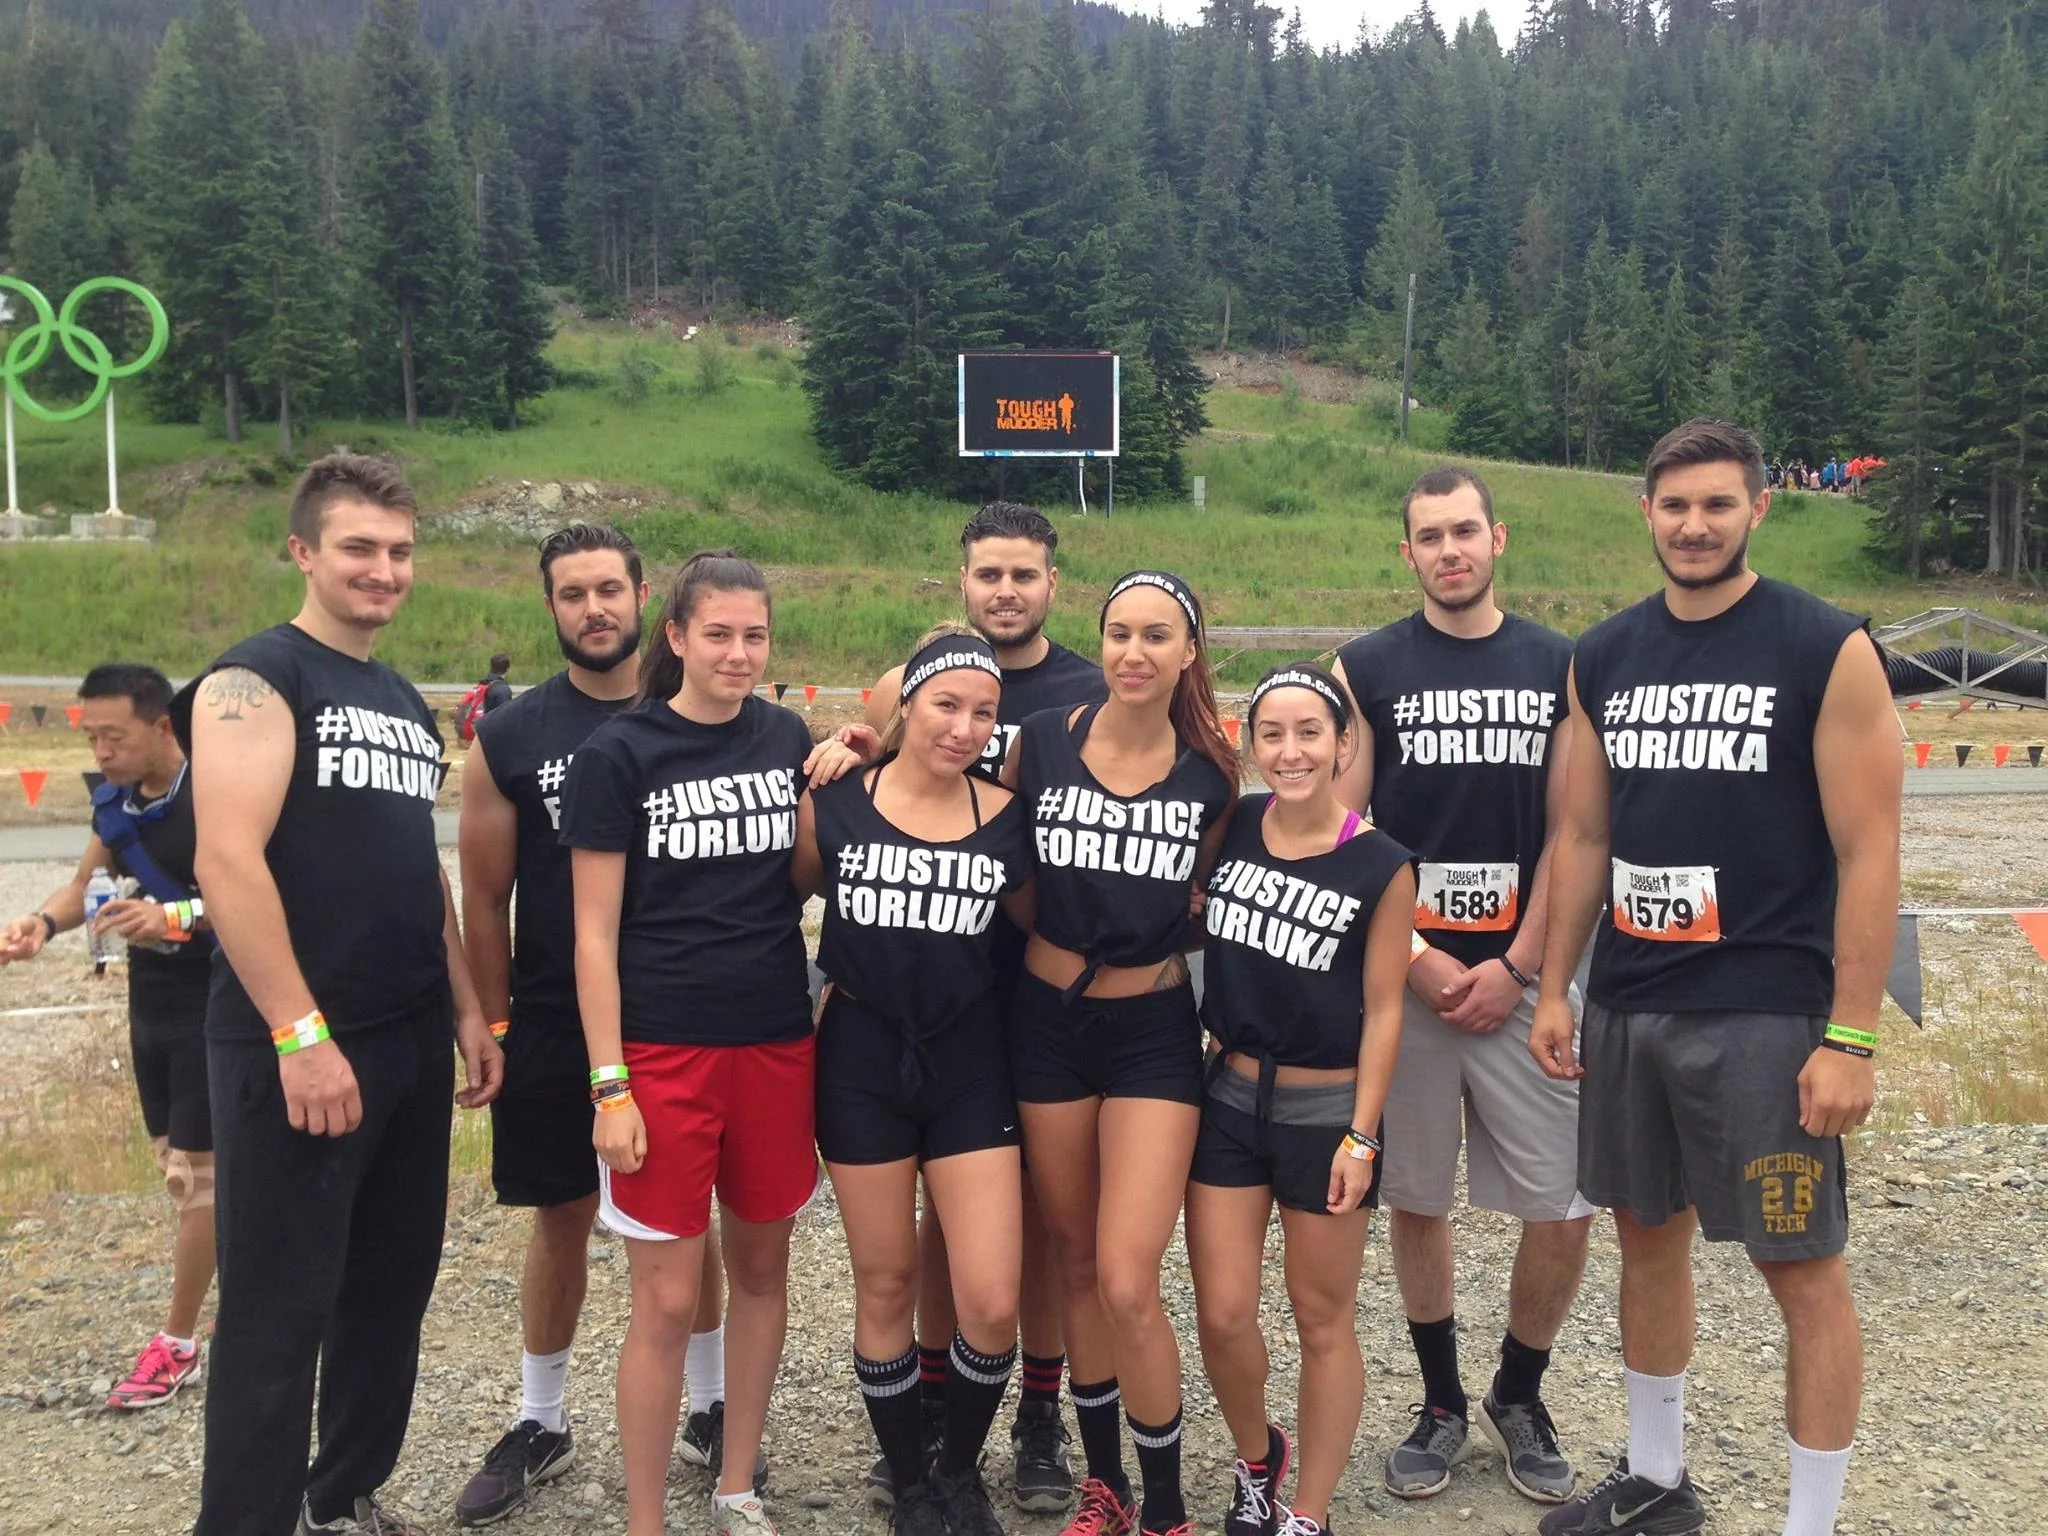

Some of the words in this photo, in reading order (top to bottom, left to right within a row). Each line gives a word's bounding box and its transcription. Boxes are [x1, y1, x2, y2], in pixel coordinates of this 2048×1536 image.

[996, 417, 1058, 431] MUDDER
[997, 398, 1056, 418] TOUGH
[1393, 689, 1556, 727] #JUSTICE
[1603, 683, 1777, 727] #JUSTICE
[1398, 728, 1546, 766] FORLUKA
[1603, 729, 1768, 772] FORLUKA
[317, 747, 440, 801] FORLUK
[643, 768, 798, 824] #JUSTICE
[1036, 786, 1204, 840] #JUSTICE
[1035, 826, 1196, 881] FORLUKA
[1447, 870, 1479, 880] TOUGH
[1629, 872, 1660, 885] TOUGH
[1208, 859, 1362, 933] #JUSTICE
[1434, 889, 1500, 920] 1583
[1624, 893, 1694, 930] 1579
[1206, 896, 1340, 972] ORLUKA
[1744, 1152, 1824, 1182] MICHIGAN
[1763, 1213, 1807, 1233] TECH
